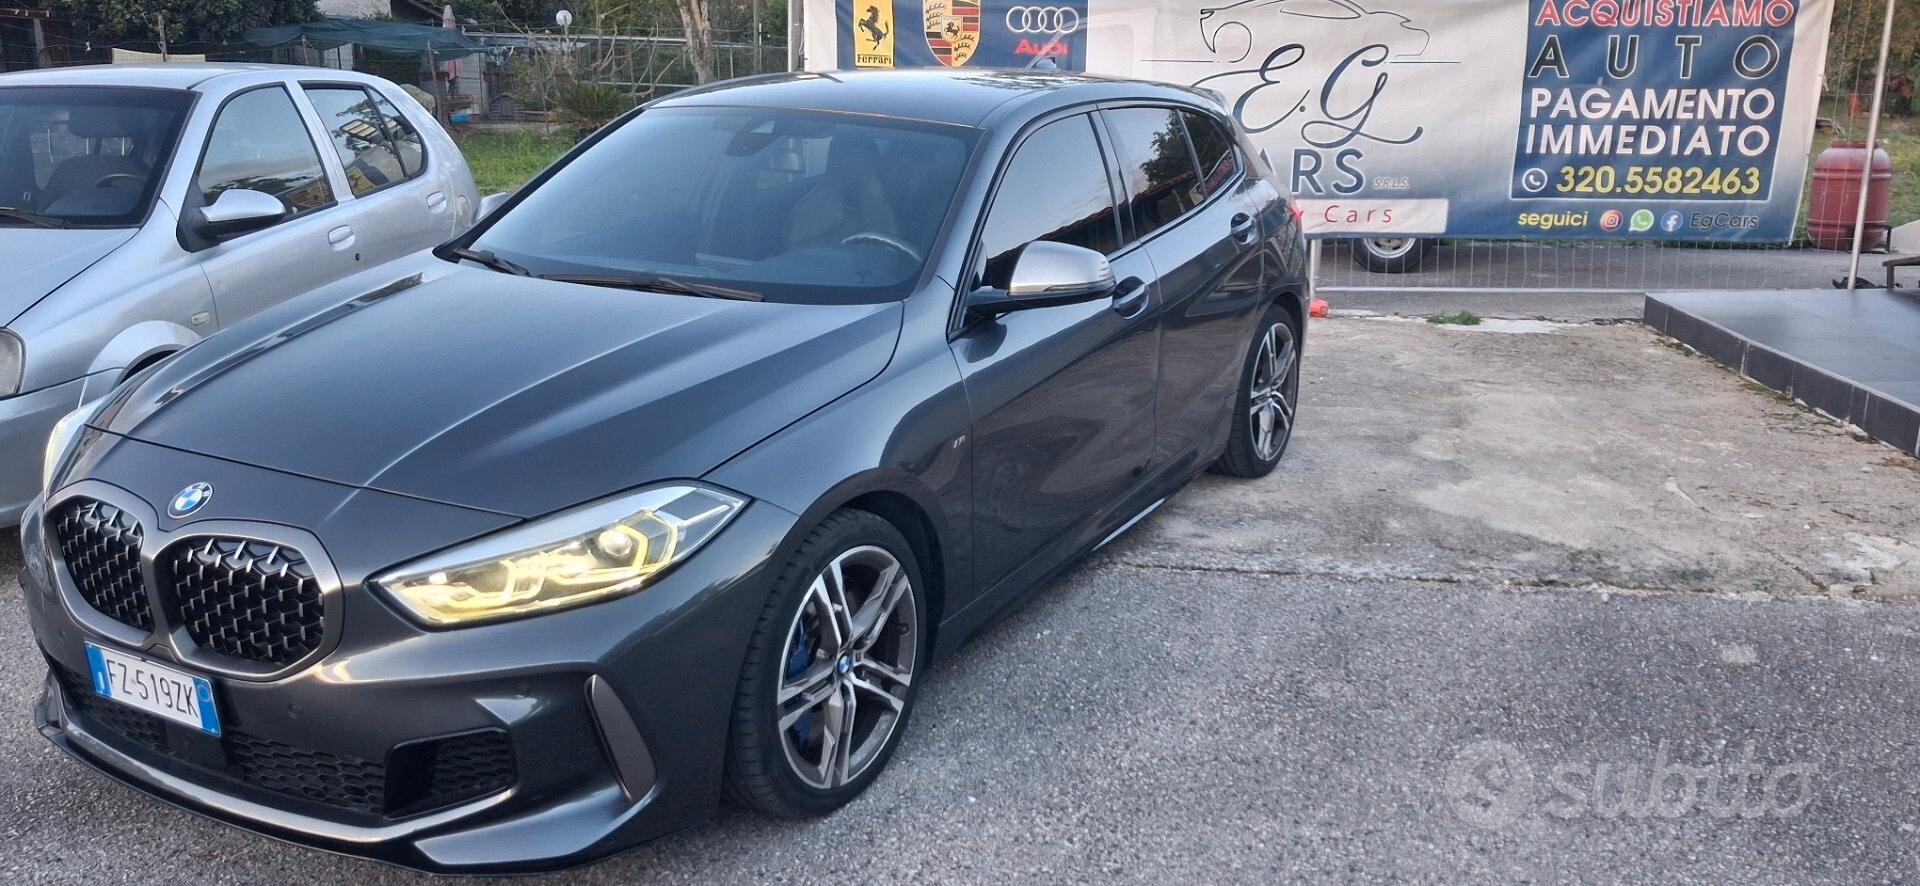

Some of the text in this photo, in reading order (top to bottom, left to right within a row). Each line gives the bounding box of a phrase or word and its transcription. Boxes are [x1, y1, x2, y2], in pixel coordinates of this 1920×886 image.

[1535, 0, 1794, 26] ACQUISTIAMO
[857, 54, 892, 64] Ferrari
[1528, 35, 1780, 79] AUTO
[1530, 87, 1775, 120] PAGAMENTO
[1526, 124, 1770, 156] IMMEDIATO
[1556, 166, 1760, 194] 320.5582463
[1324, 205, 1392, 223] Cars
[1518, 211, 1588, 229] seguici
[1690, 212, 1758, 231] EgCars
